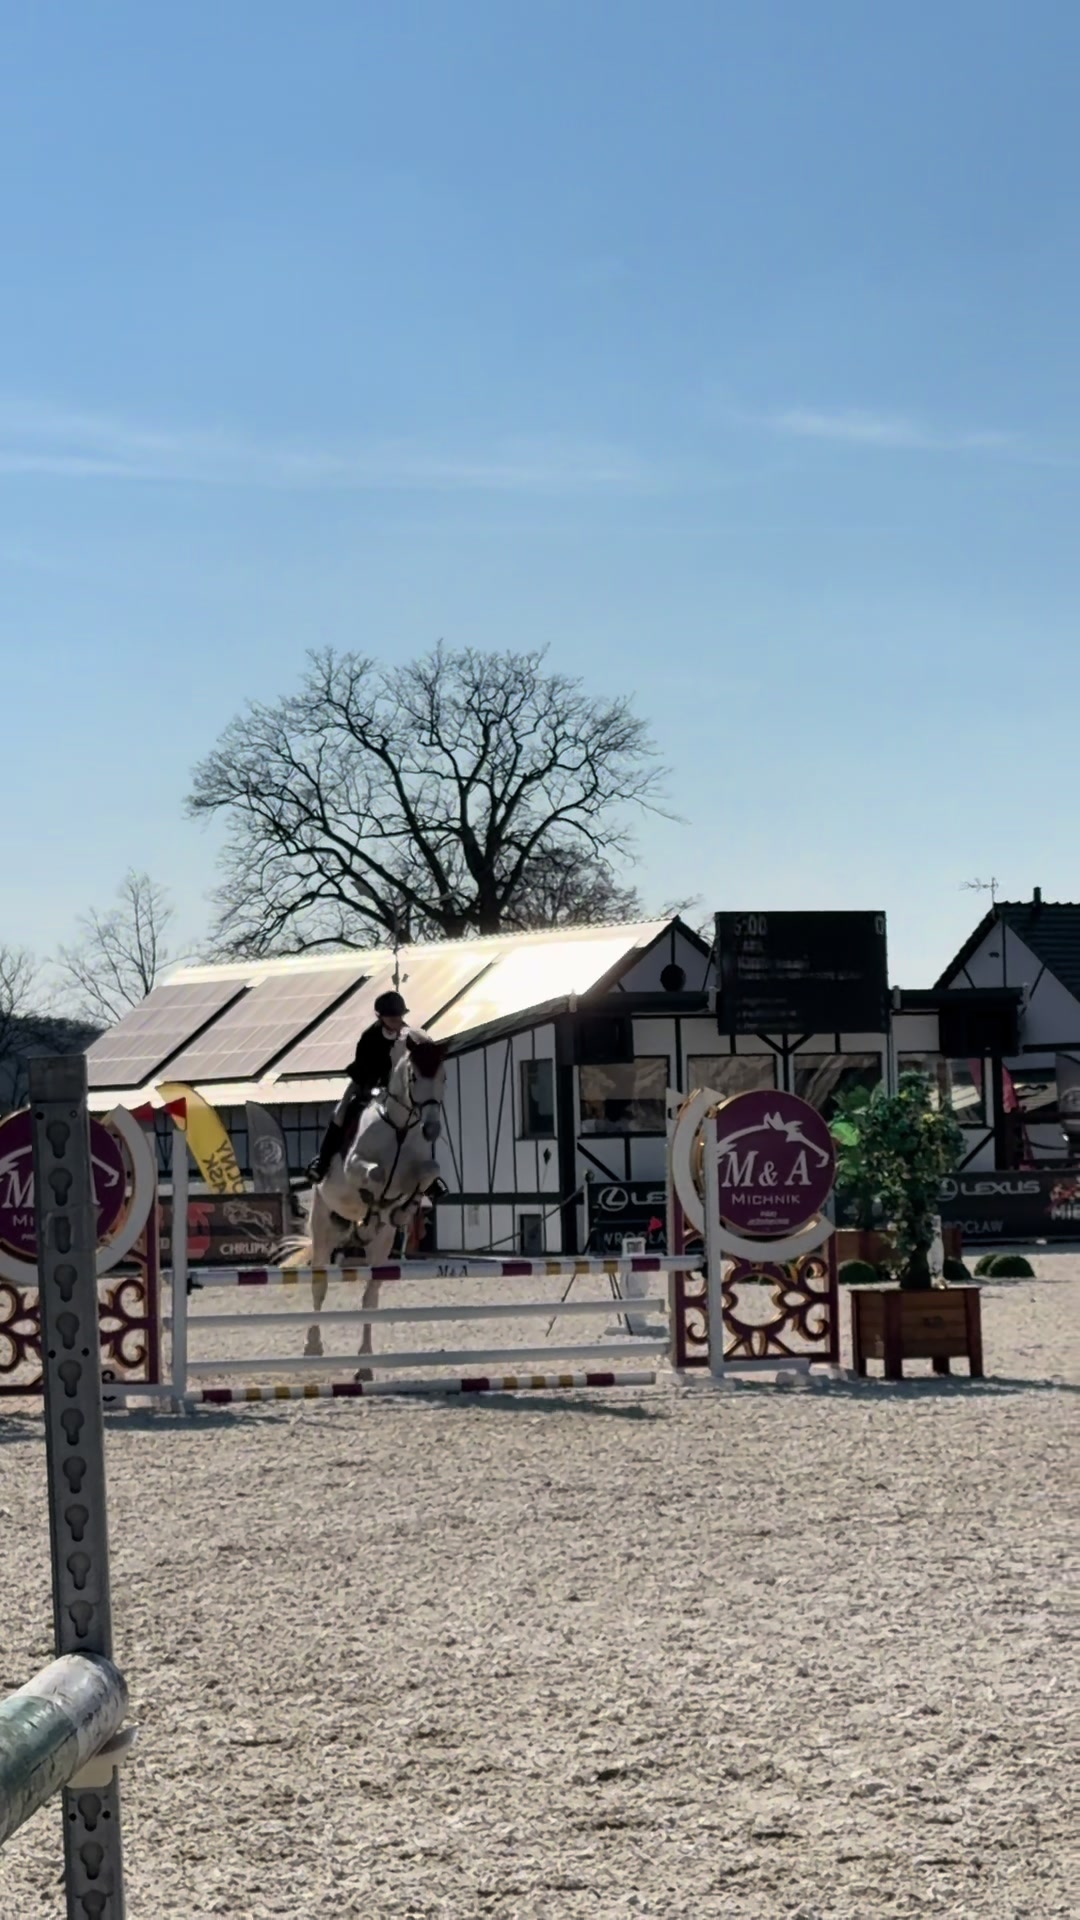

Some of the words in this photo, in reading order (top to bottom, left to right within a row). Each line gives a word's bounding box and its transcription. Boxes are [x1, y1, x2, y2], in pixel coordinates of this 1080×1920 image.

[961, 1180, 1041, 1196] LEXUS
[631, 1191, 668, 1205] LE
[732, 1194, 800, 1205] MICHNIK
